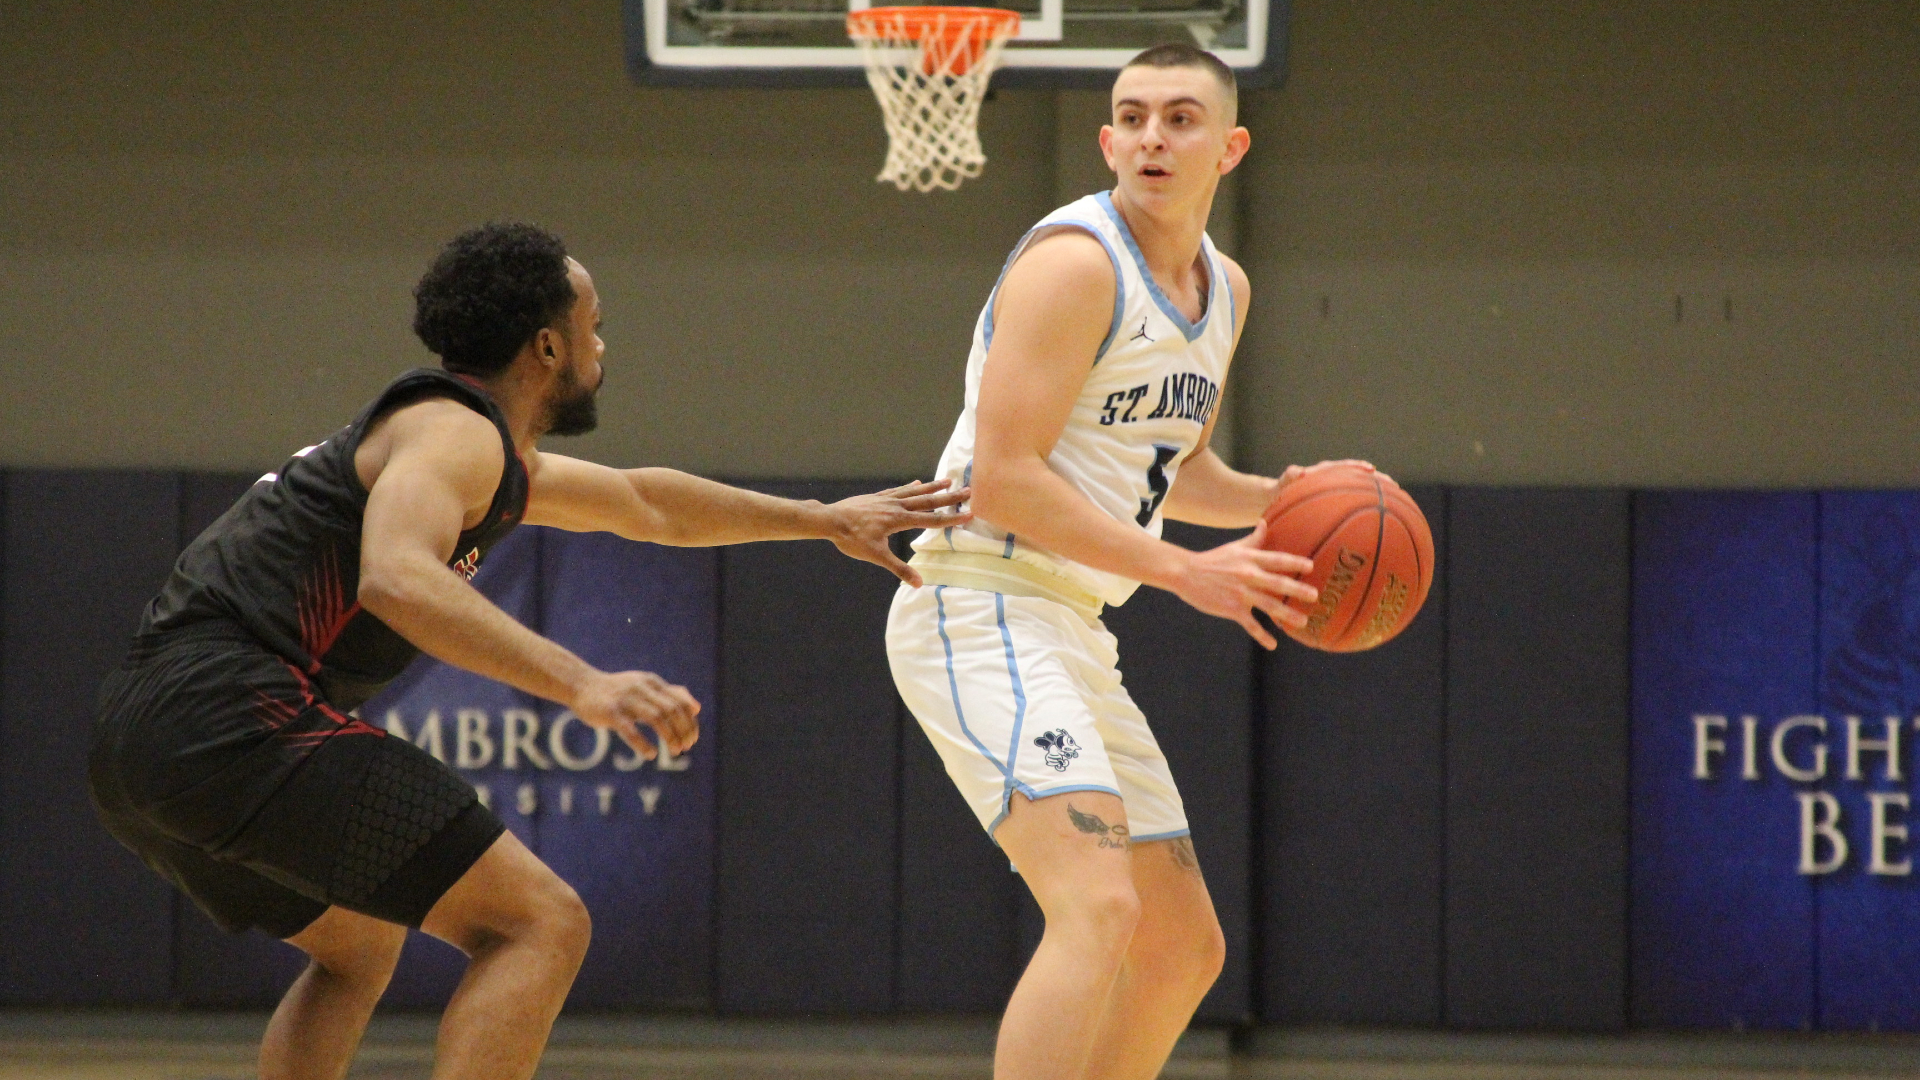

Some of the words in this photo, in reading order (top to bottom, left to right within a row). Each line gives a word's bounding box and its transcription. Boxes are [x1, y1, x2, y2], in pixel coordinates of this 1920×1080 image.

[1099, 383, 1149, 426] ST.
[1146, 372, 1218, 427] AMBRO
[1134, 443, 1182, 528] 5
[1692, 713, 1920, 781] FIGH
